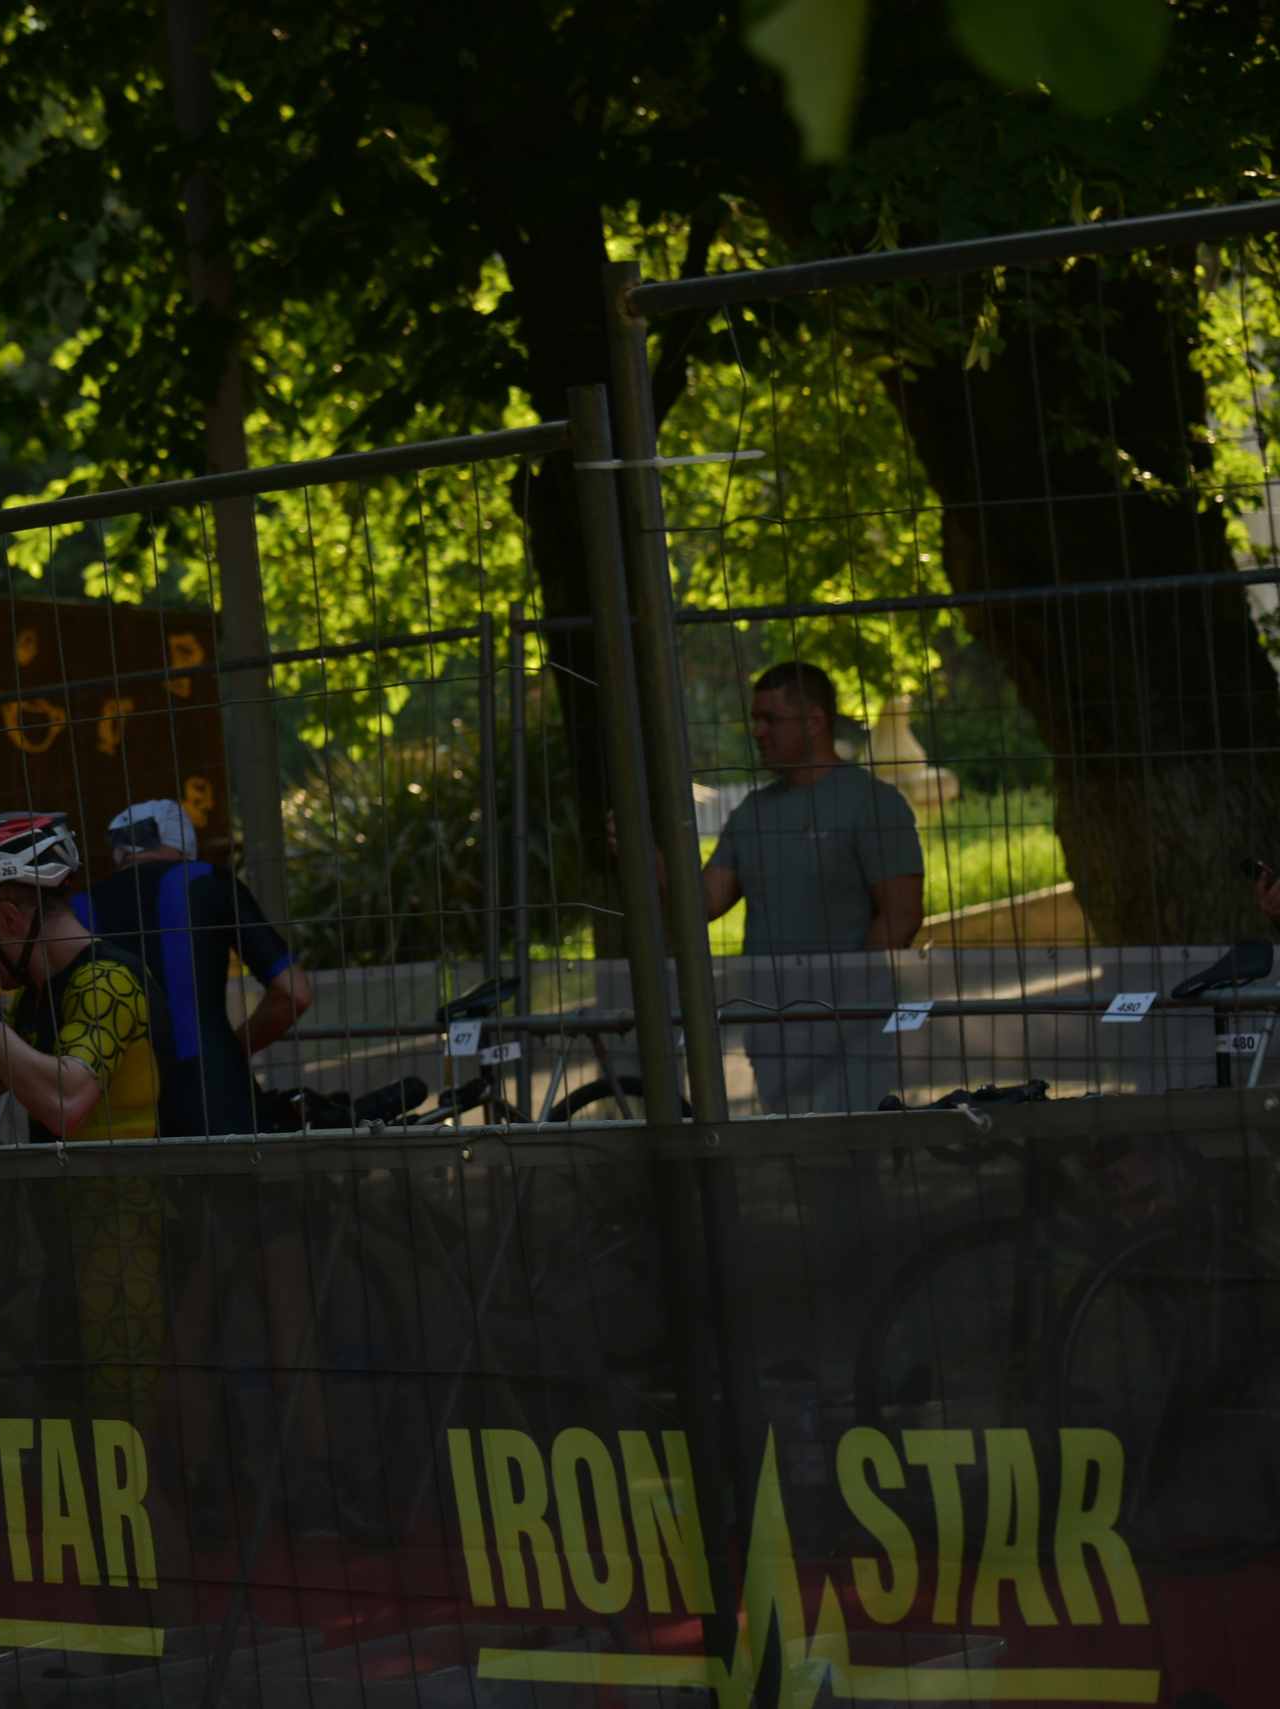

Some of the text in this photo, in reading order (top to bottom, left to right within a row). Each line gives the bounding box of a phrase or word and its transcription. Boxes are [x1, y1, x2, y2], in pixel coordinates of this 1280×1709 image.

[1, 865, 18, 877] 263
[1117, 1001, 1141, 1012] 480
[454, 1032, 472, 1044] 477
[1232, 1036, 1255, 1049] 480
[446, 1426, 1150, 1626] IRON STAR
